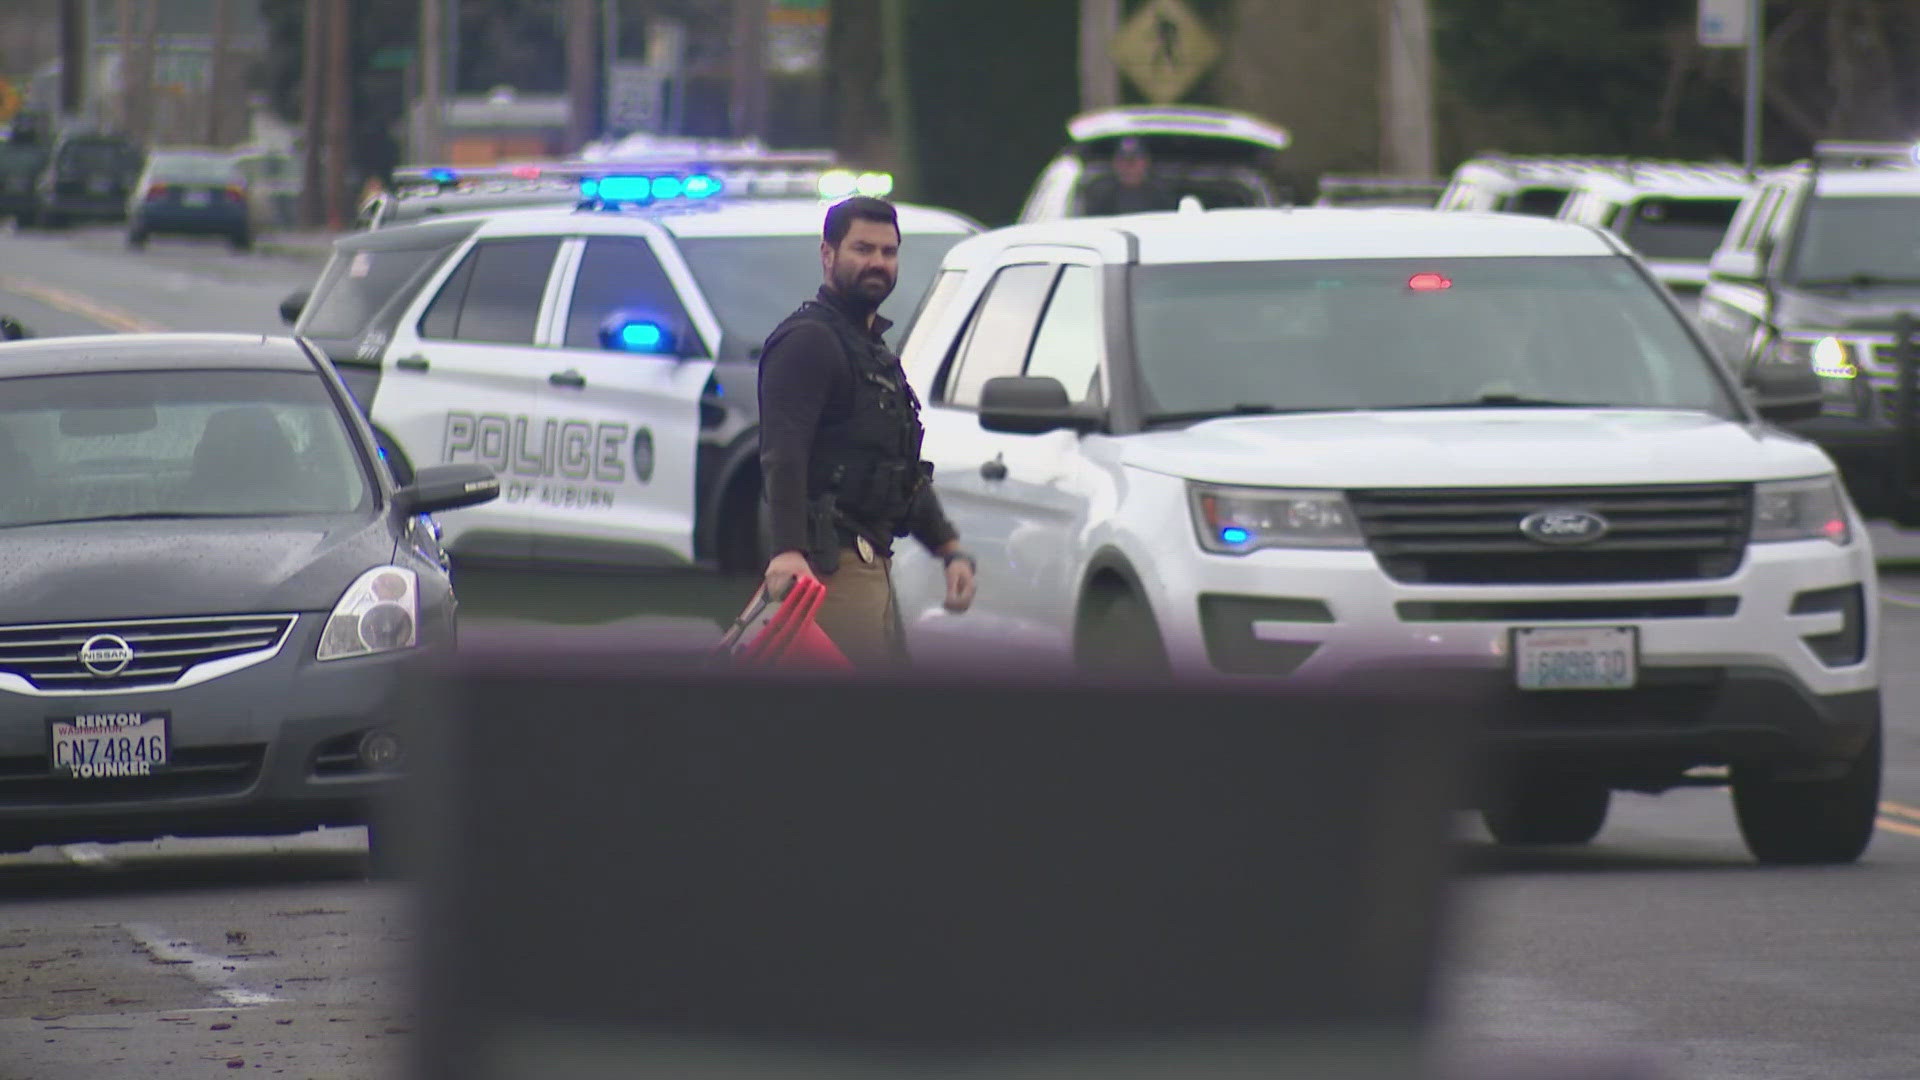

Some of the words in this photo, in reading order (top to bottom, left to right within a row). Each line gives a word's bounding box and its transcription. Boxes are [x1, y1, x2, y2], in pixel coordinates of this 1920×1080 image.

[442, 410, 629, 482] POLICE
[84, 650, 127, 660] NISSAN
[75, 713, 141, 728] RENTON
[70, 762, 151, 779] YOUNKER
